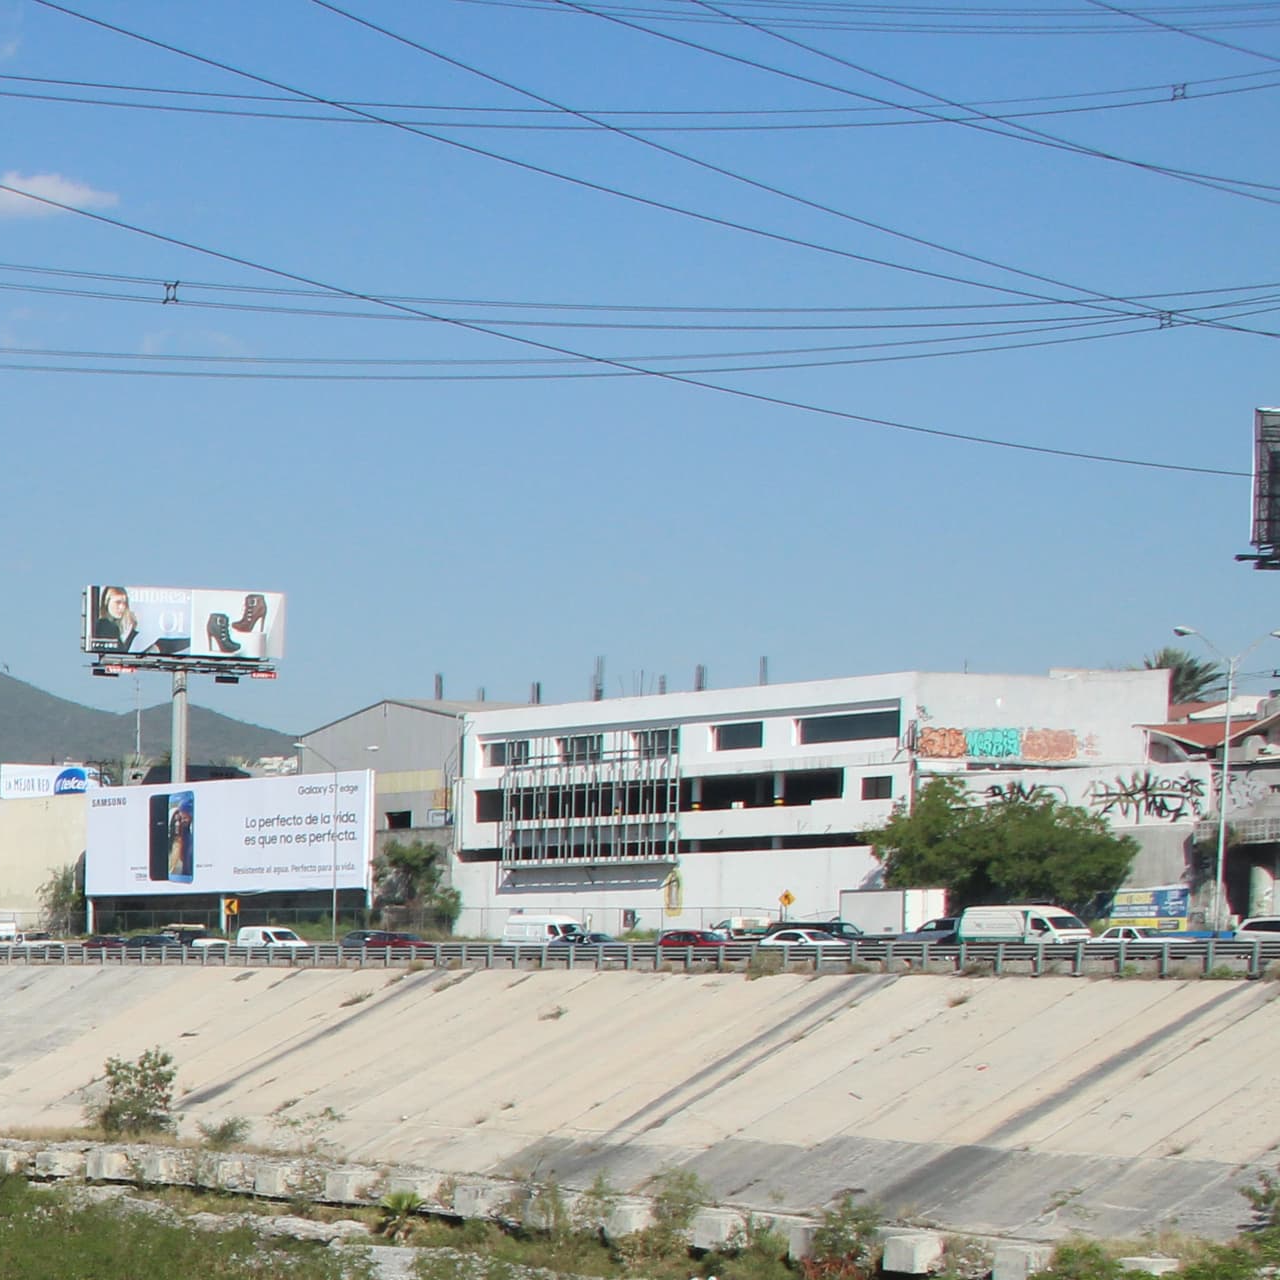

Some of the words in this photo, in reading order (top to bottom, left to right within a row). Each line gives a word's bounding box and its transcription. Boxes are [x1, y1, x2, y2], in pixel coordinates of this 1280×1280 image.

[298, 785, 328, 796] Galaxy
[340, 784, 358, 794] edge
[92, 797, 127, 807] SAMSUNG
[245, 817, 257, 829] Lo
[258, 814, 303, 831] perfecto
[305, 813, 318, 825] de
[320, 812, 330, 824] la
[244, 835, 256, 846] es
[258, 834, 278, 848] que
[280, 833, 293, 845] no
[295, 832, 307, 843] es
[233, 866, 265, 875] Resistente
